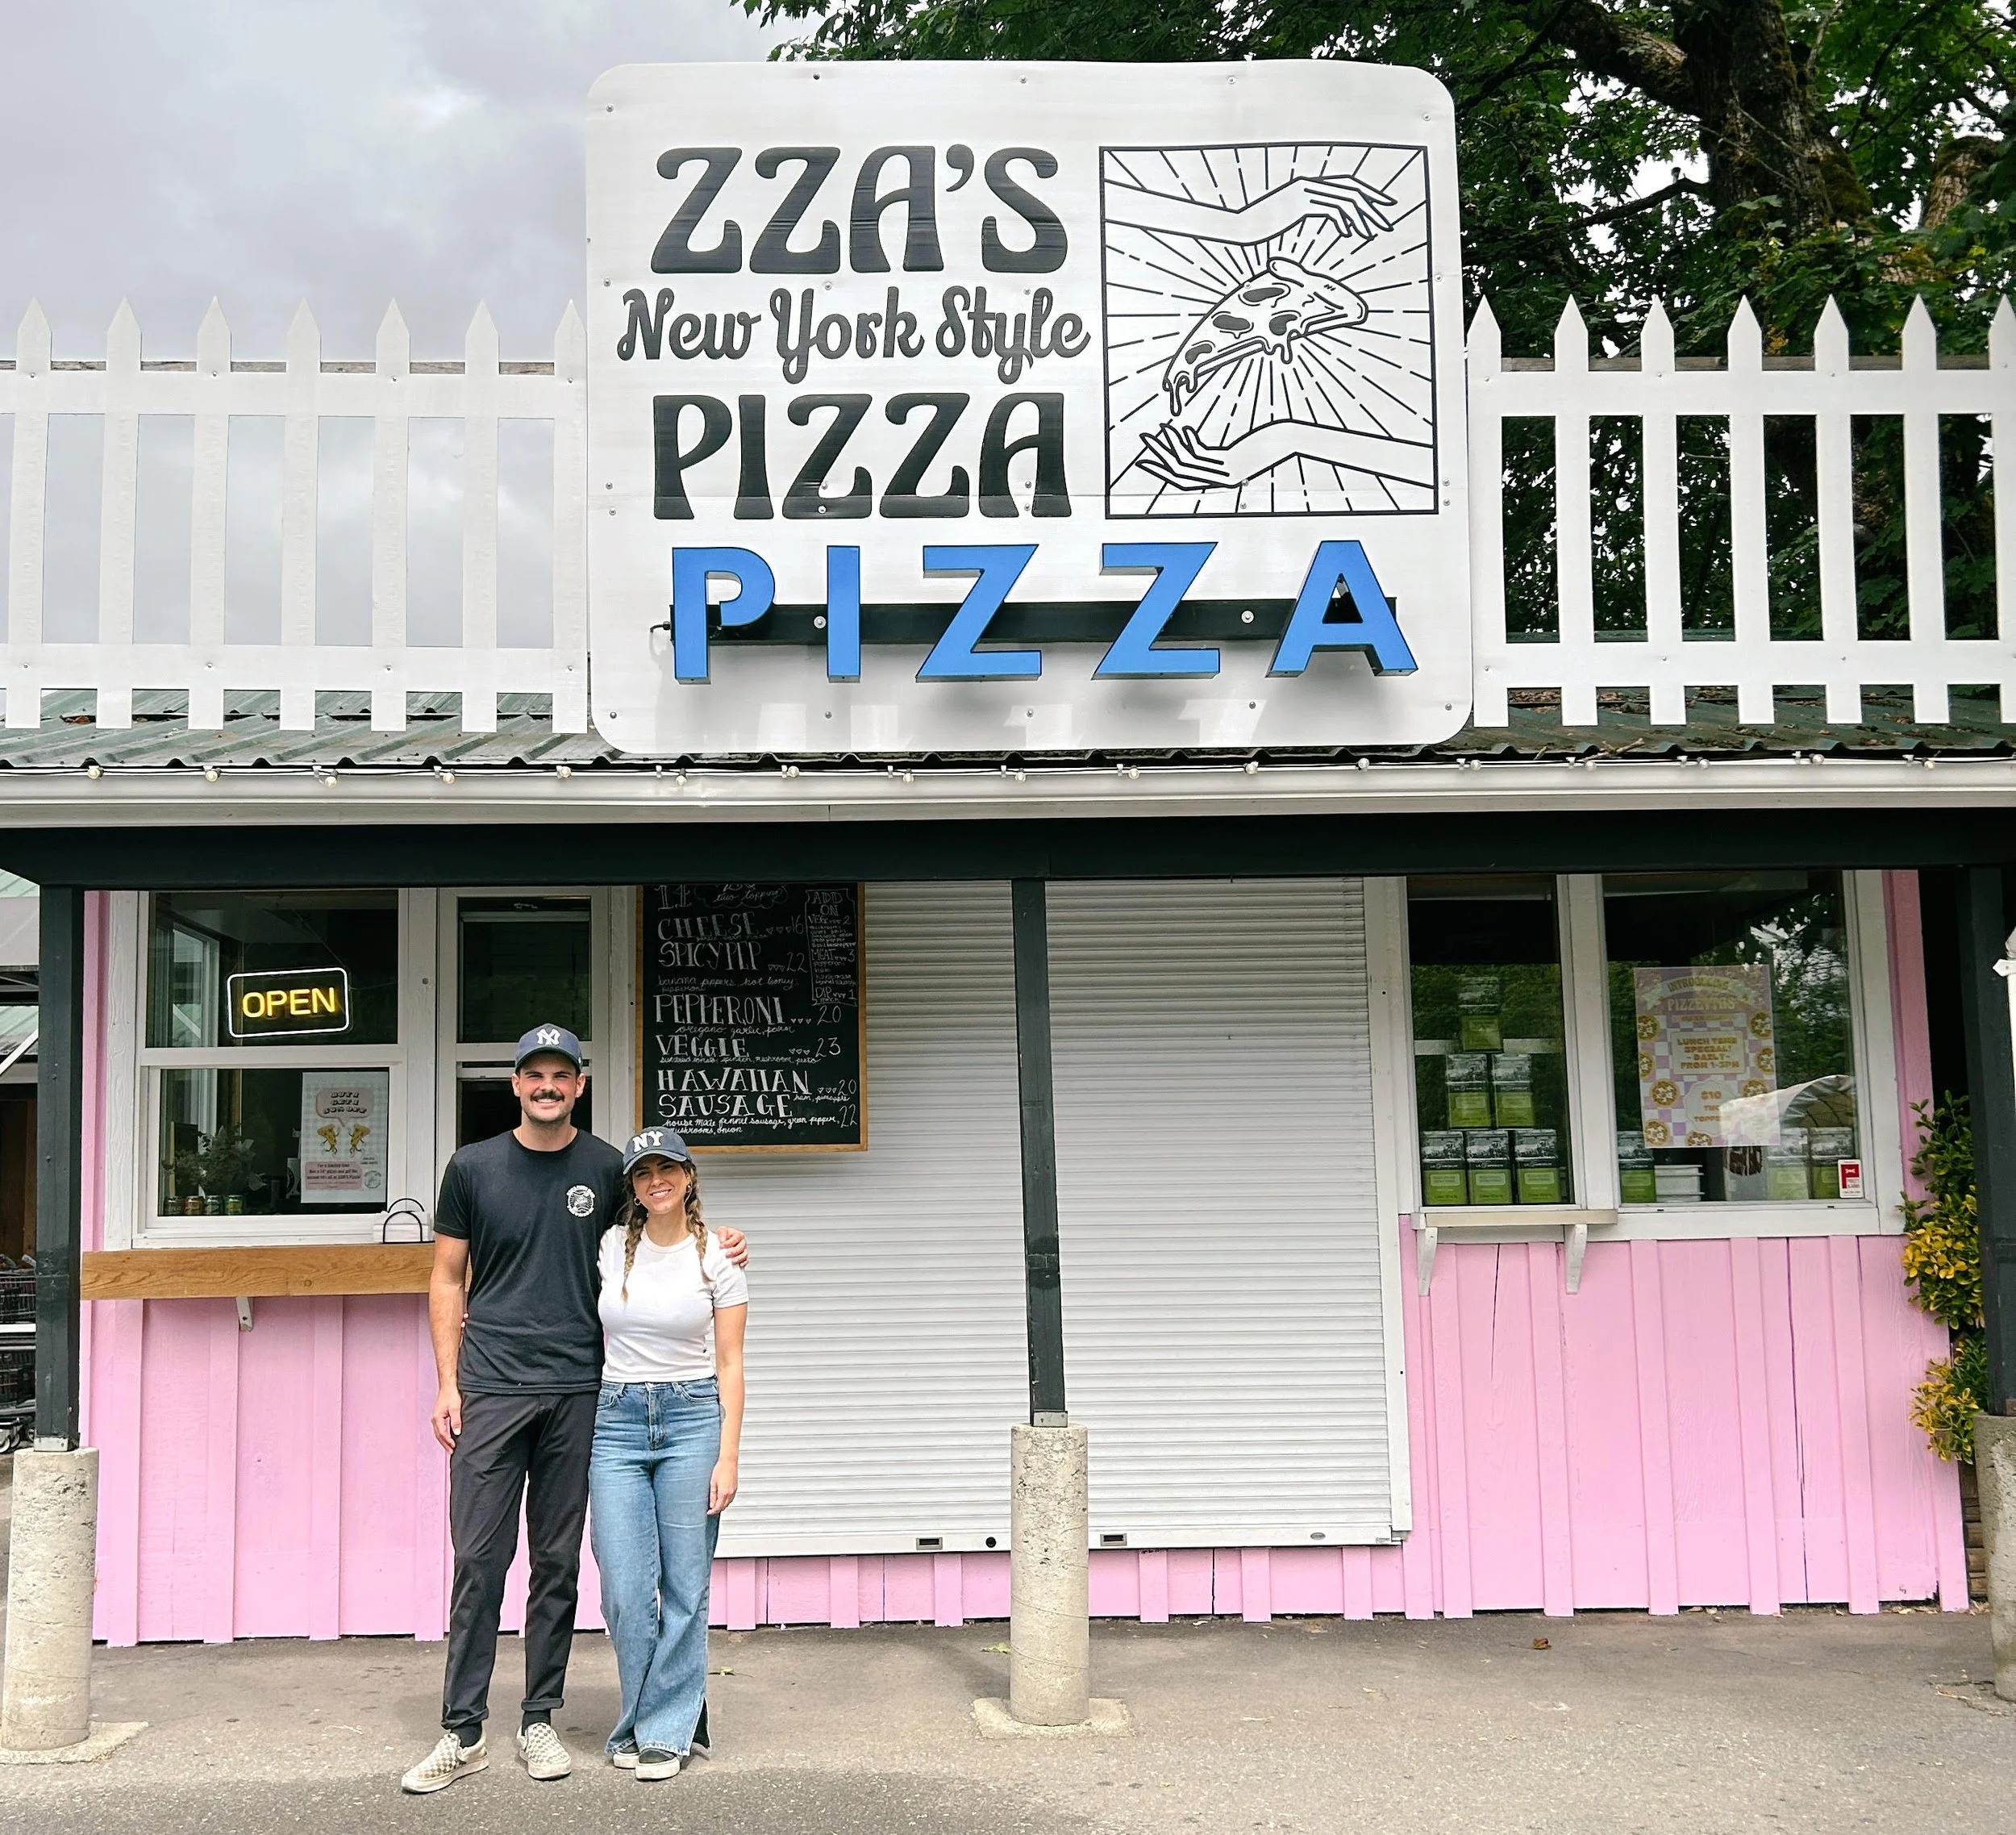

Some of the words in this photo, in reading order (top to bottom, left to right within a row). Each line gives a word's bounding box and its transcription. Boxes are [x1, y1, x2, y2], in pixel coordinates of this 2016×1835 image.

[650, 144, 1068, 275] ZZA'S
[616, 287, 762, 361] New
[769, 285, 926, 385] York
[935, 285, 1092, 385] Style
[652, 392, 1073, 520] PIZZA
[673, 541, 1418, 684] PIZZA
[811, 891, 843, 904] ADD
[819, 904, 839, 916] ON
[657, 911, 759, 940] CHEESE
[791, 914, 804, 935] 16
[843, 915, 852, 925] 2
[658, 941, 723, 971] SPICY
[723, 941, 761, 971] PEP
[786, 952, 808, 973] 22
[811, 949, 836, 961] MEAT
[848, 949, 856, 962] 3
[657, 974, 697, 986] banana
[815, 986, 832, 999] DIP
[848, 989, 857, 1000] 1
[242, 986, 335, 1018] OPEN
[653, 994, 786, 1025] PEPPERONI
[817, 1005, 842, 1025] 20
[536, 1028, 560, 1045] NY
[656, 1034, 750, 1057] VEGGIE
[814, 1036, 841, 1058] 23
[1680, 1061, 1708, 1069] FROM
[658, 1067, 812, 1095] HAWAIIAN
[838, 1078, 857, 1095] 20
[658, 1094, 793, 1118] SAUSAGE
[839, 1103, 858, 1128] 22
[631, 1129, 664, 1153] NY
